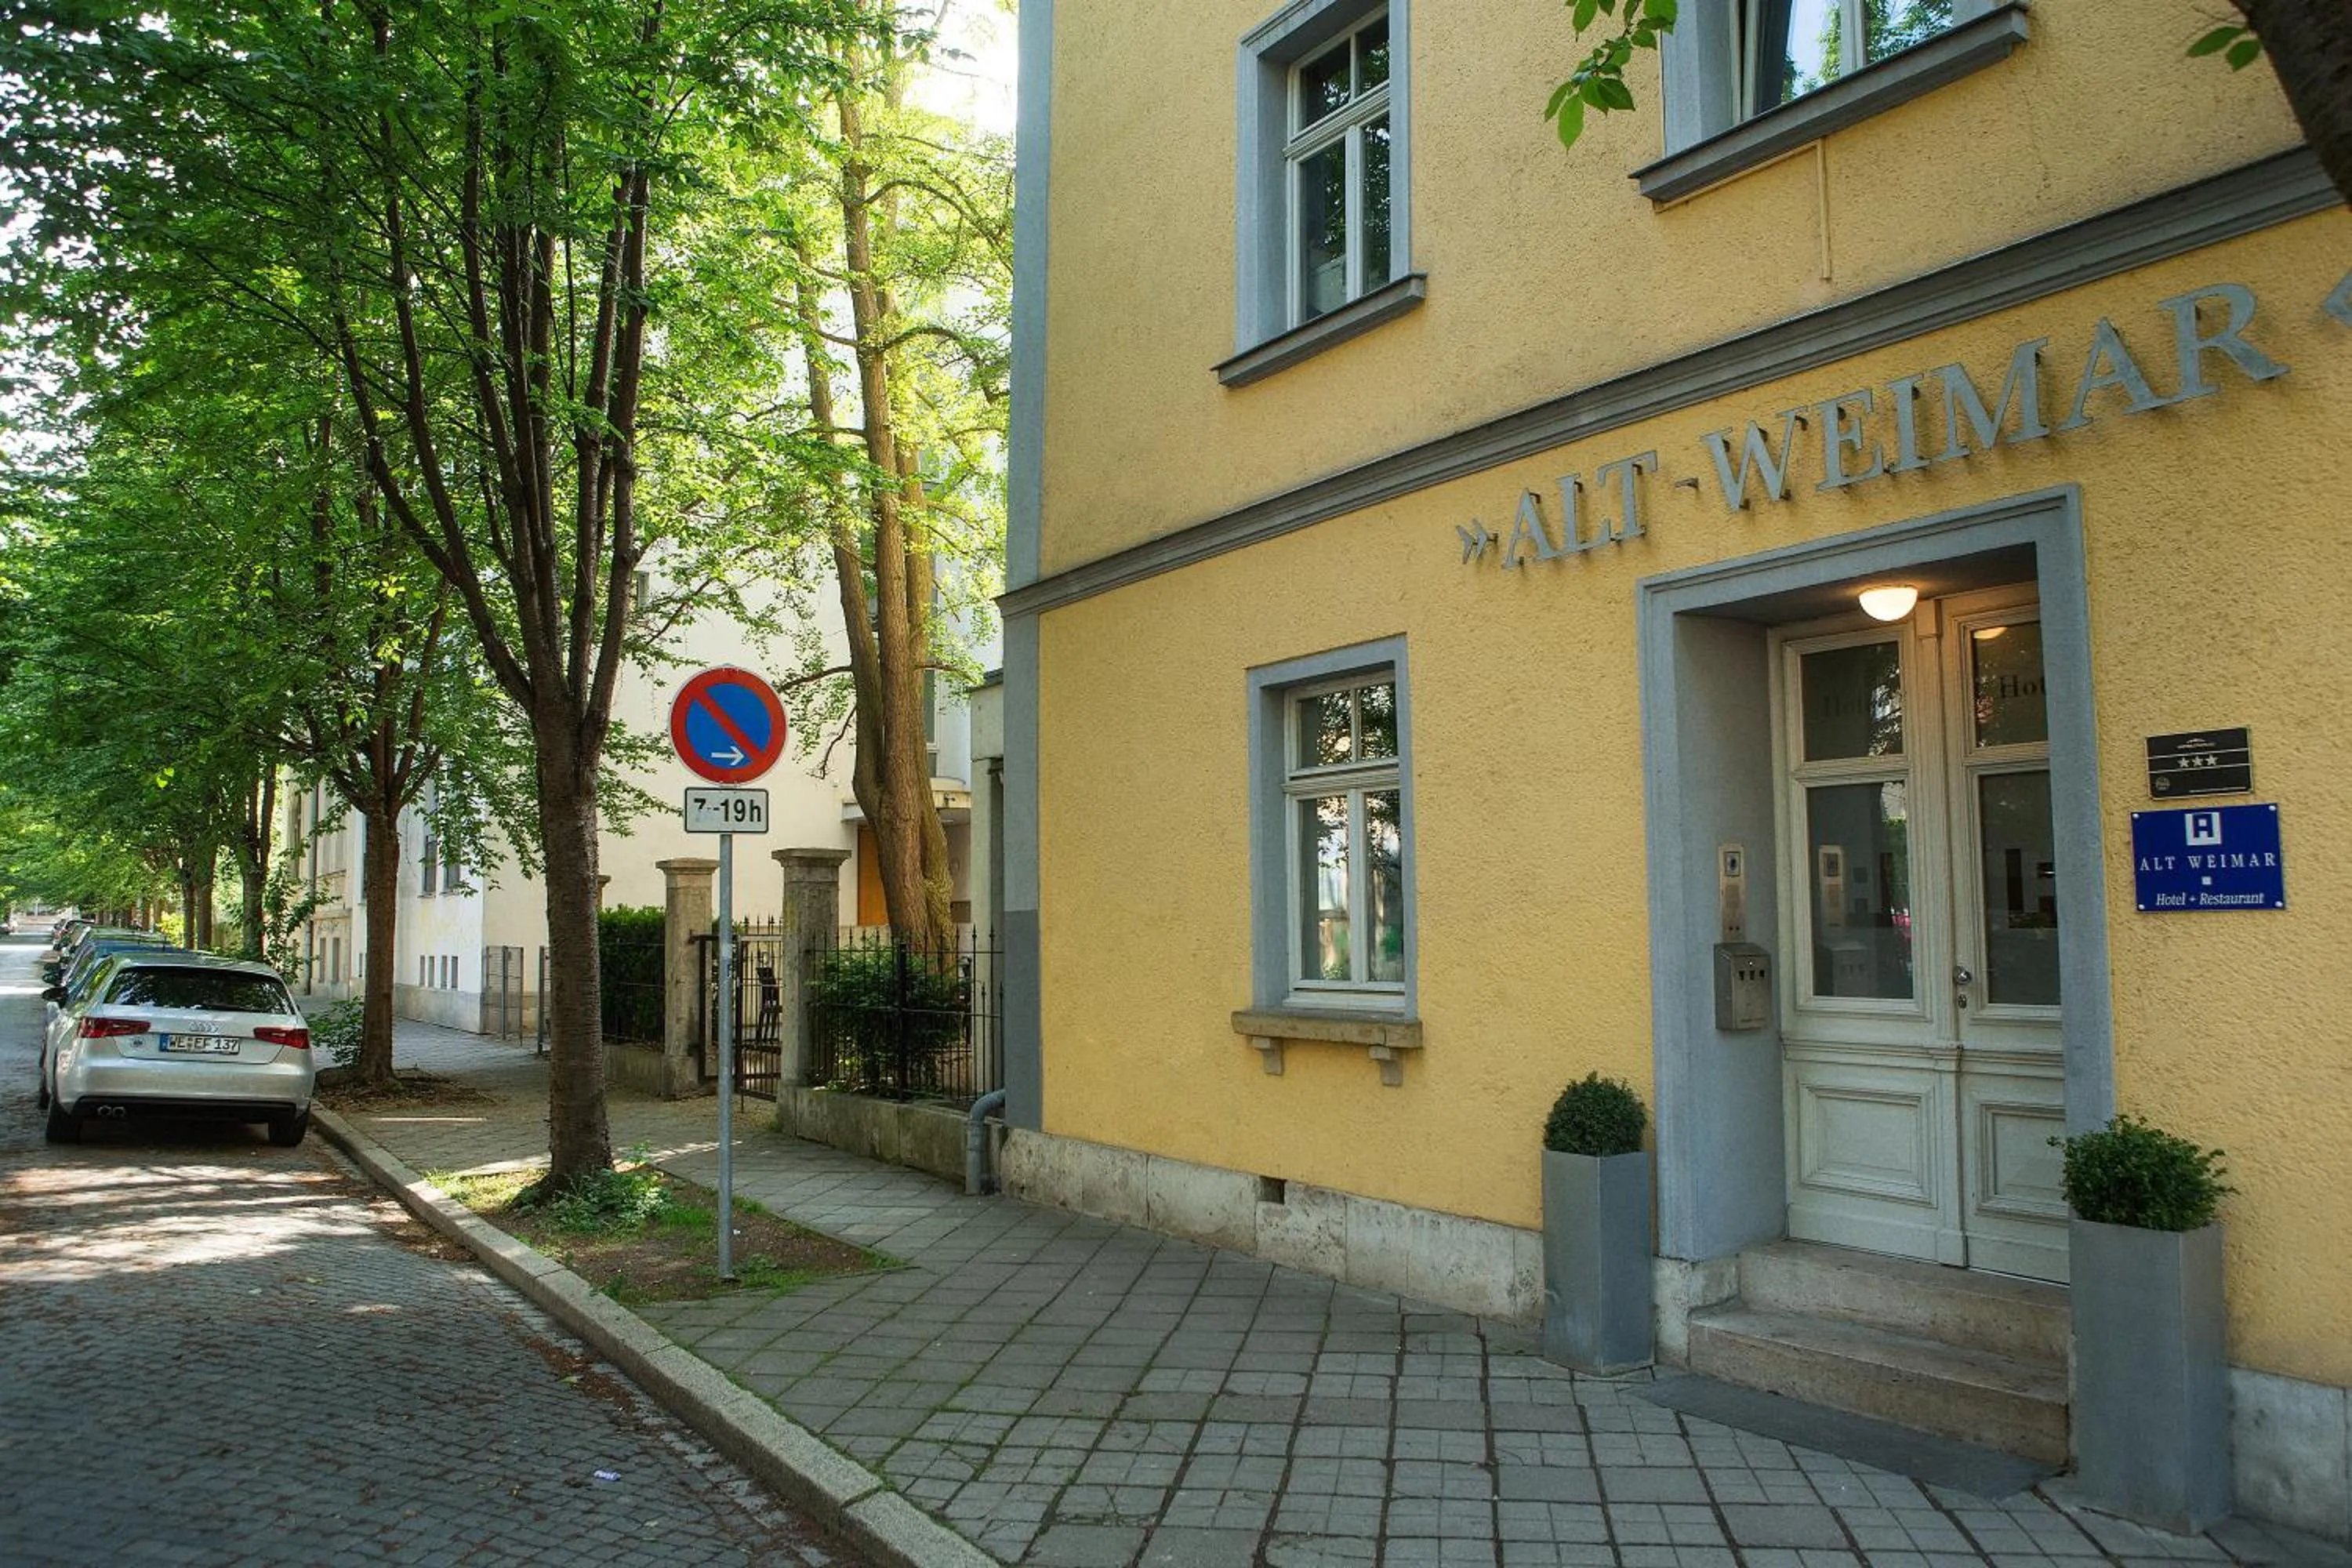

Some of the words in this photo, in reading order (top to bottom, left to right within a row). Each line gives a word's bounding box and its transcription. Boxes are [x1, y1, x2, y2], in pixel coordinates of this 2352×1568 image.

[2140, 855, 2176, 871] ALT
[2187, 852, 2276, 869] WEIMAR
[2155, 892, 2186, 906] Hotel
[2199, 891, 2264, 906] Restaurant
